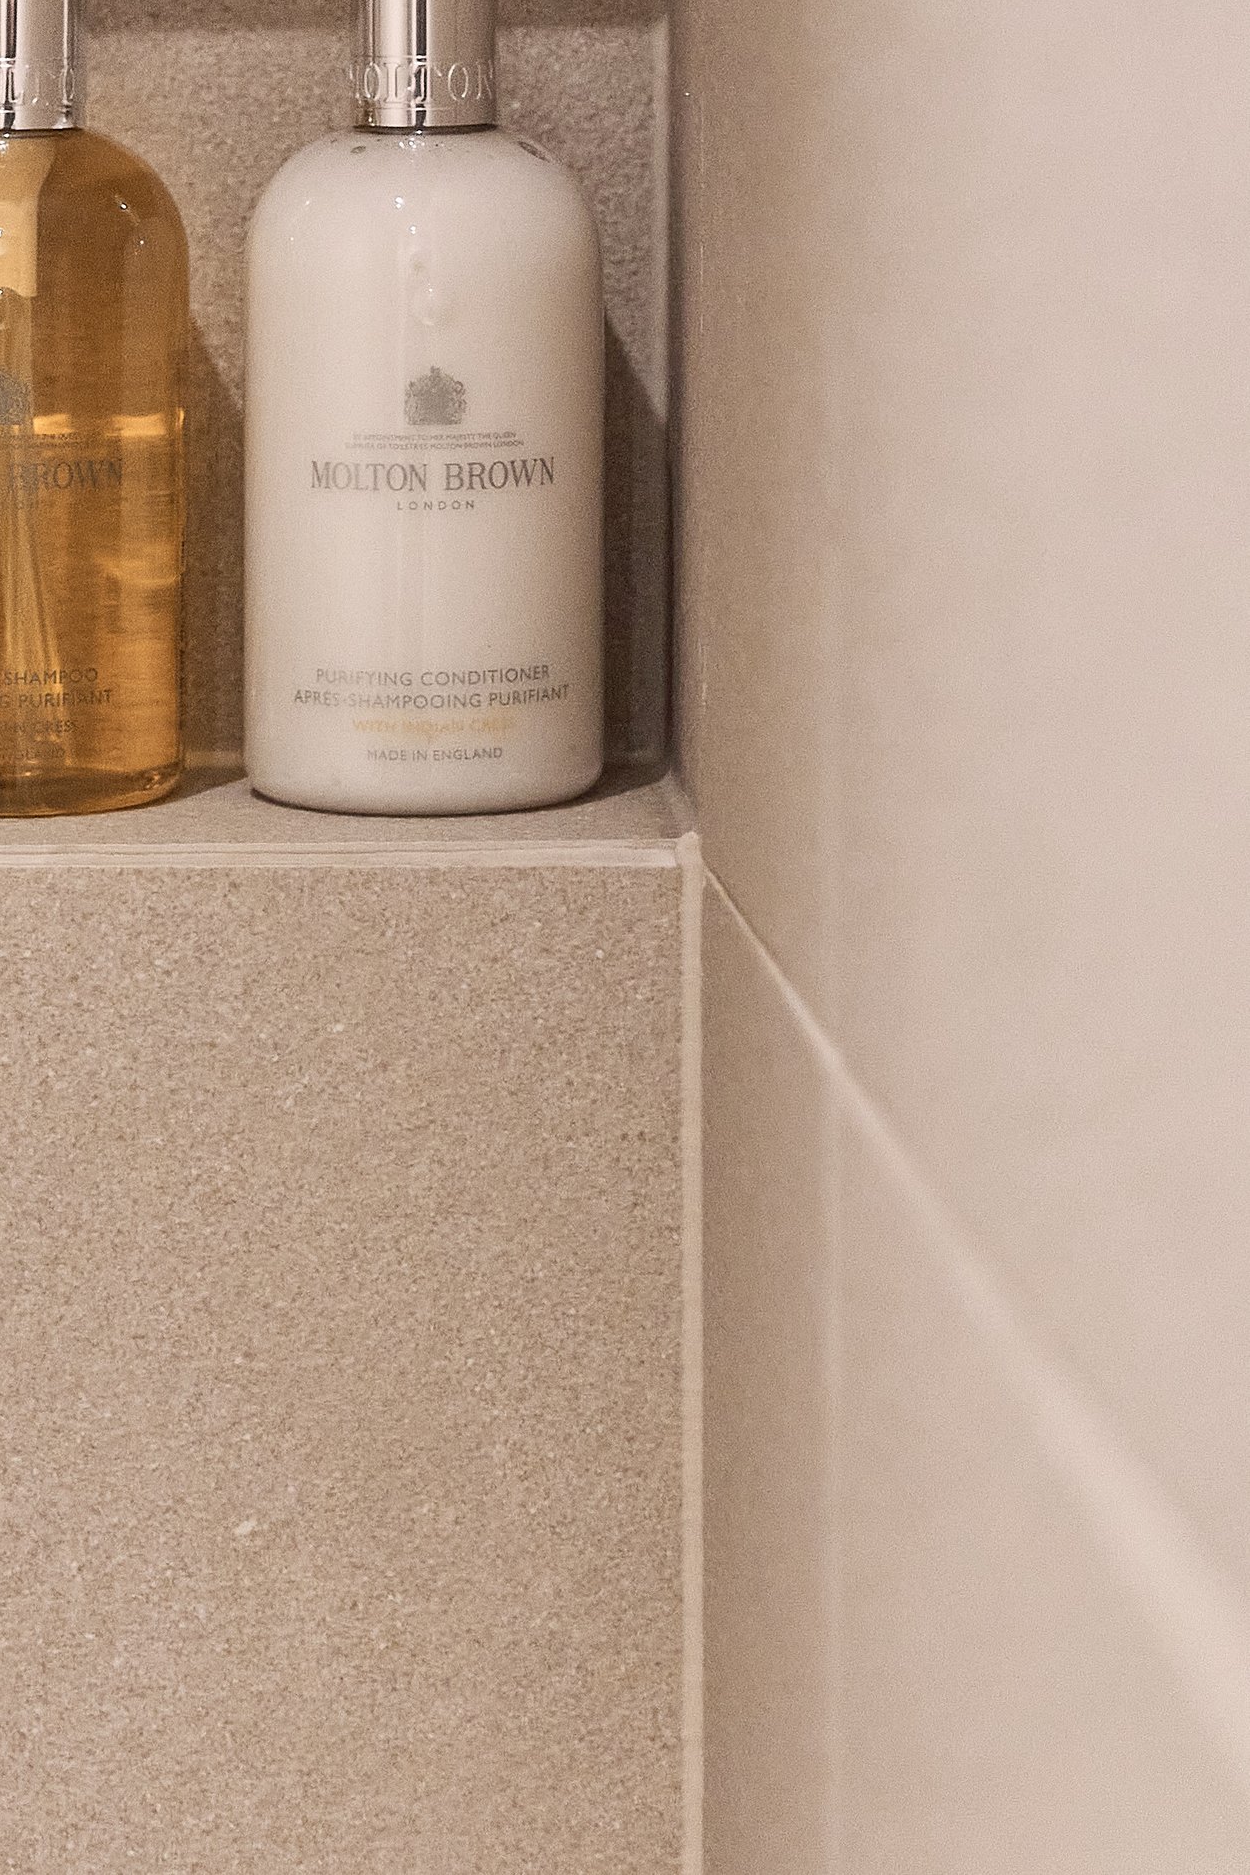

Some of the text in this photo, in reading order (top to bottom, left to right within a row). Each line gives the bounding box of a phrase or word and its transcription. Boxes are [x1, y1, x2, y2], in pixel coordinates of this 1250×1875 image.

[310, 456, 555, 492] MOLTON BROWN
[397, 500, 475, 511] LONDON
[3, 667, 99, 686] SHAMPOO
[315, 665, 550, 686] PURIFYING CONDITIONER
[17, 689, 113, 709] PURIFIANT
[488, 684, 569, 707] PURIFIANT
[367, 747, 503, 761] MADE IN ENGLAND
